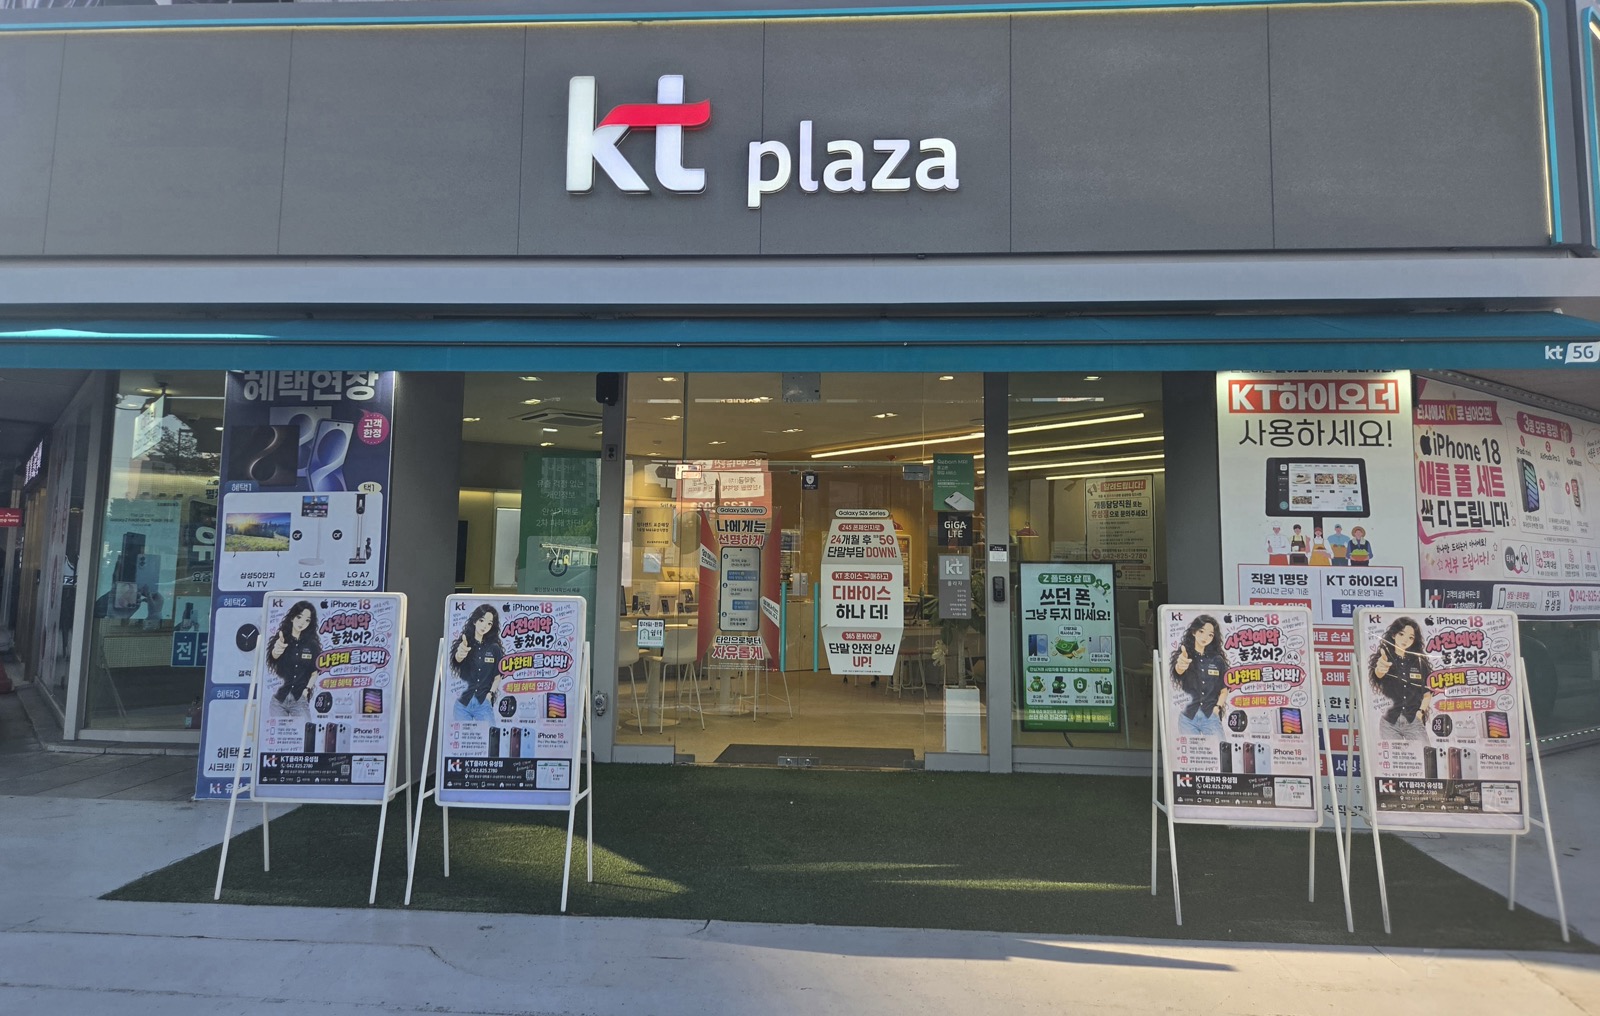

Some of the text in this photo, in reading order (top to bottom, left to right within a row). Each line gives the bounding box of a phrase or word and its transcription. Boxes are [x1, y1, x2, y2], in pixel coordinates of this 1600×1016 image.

[566, 74, 960, 210] kt plaza
[1544, 345, 1594, 360] kt 5G
[243, 371, 378, 401] 혜택연장
[1231, 382, 1397, 411] KT하이오더
[1446, 404, 1464, 421] KT로
[1464, 406, 1493, 422] 넘어오면!
[363, 418, 382, 428] 고객
[1523, 414, 1535, 432] 3종
[363, 428, 382, 438] 한정
[1239, 418, 1392, 448] 사용하세요!
[1432, 432, 1501, 465] iPhone 18
[1418, 461, 1506, 497] 애플 풀 세트
[231, 482, 252, 492] 혜택1
[363, 483, 375, 492] 택1
[1103, 481, 1144, 491] 알려드립니다!
[1094, 500, 1132, 509] 개통담당직원
[1120, 509, 1148, 518] 문의주세요!
[1421, 499, 1434, 528] 싹
[1438, 500, 1452, 526] 다
[1454, 500, 1510, 528] 드립니다!
[716, 520, 766, 533] 나에게는
[944, 520, 967, 530] GiGA
[293, 532, 302, 540] or
[333, 531, 342, 539] or
[718, 534, 764, 546] 선명하게
[830, 534, 872, 545] 24개월 후
[947, 530, 963, 538] LTE
[827, 546, 897, 558] 단말부담 DOWN!
[1444, 551, 1489, 574] 전부 드립니다!
[1521, 551, 1528, 566] kt
[945, 558, 963, 575] kt
[240, 572, 276, 580] 삼성50인치
[1251, 573, 1308, 586] 직원 1명당
[1326, 575, 1398, 587] KT 하이오더
[247, 580, 268, 588] AI TV
[302, 579, 322, 588] 모니터
[342, 579, 374, 588] 무선청소기
[832, 585, 891, 600] 디바이스
[1251, 587, 1280, 595] 240시간
[1297, 588, 1309, 596] 기준
[1357, 589, 1384, 597] 운영기준
[224, 597, 247, 608] 혜택2
[1040, 588, 1095, 608] 쓰던 폰,
[272, 599, 371, 610] kt iPhone 18
[455, 602, 553, 614] kt iPhone 18
[1545, 599, 1561, 611] 유성점
[836, 604, 888, 620] 하나 더!
[1025, 608, 1110, 621] 그냥 두지 마세요!
[319, 612, 372, 633] 사전예약
[1171, 612, 1280, 625] kt iPhone 18
[1369, 614, 1483, 627] kt iPhone 18
[501, 616, 553, 637] 사전예약
[331, 631, 372, 645] 놓쳤어?
[513, 635, 554, 649] 놓쳤어?
[716, 635, 762, 645] 타인으로부터
[1224, 628, 1280, 650] 사전예약
[1331, 632, 1350, 642] 손실
[1426, 630, 1485, 653] 사전예약
[176, 642, 192, 661] 전
[712, 646, 765, 660] 자유롭게
[829, 643, 896, 655] 단말 안전 안심
[1238, 647, 1282, 661] 놓쳤어?
[319, 650, 386, 668] 나한테 물어봐!
[501, 653, 568, 672] 나한테 물어봐!
[852, 656, 872, 668] UP!
[1441, 650, 1488, 664] 놓쳤어?
[353, 677, 370, 686] 연장!
[1227, 667, 1300, 684] 나한테 물어봐!
[1430, 670, 1506, 689] 나한테 물어봐!
[537, 682, 554, 691] 연장!
[216, 689, 240, 699] 혜택3
[1252, 696, 1268, 706] 혜택
[1268, 696, 1286, 705] 연장!
[1456, 700, 1472, 710] 혜택
[1473, 699, 1492, 708] 연장!
[217, 747, 240, 758] 혜택
[208, 763, 235, 772] 시크릿!
[262, 755, 278, 768] kt
[447, 758, 463, 772] kt
[489, 760, 504, 768] 유성점
[1177, 774, 1193, 788] kt
[1222, 776, 1238, 784] 유성점
[210, 783, 222, 794] kt
[1378, 780, 1396, 793] kt
